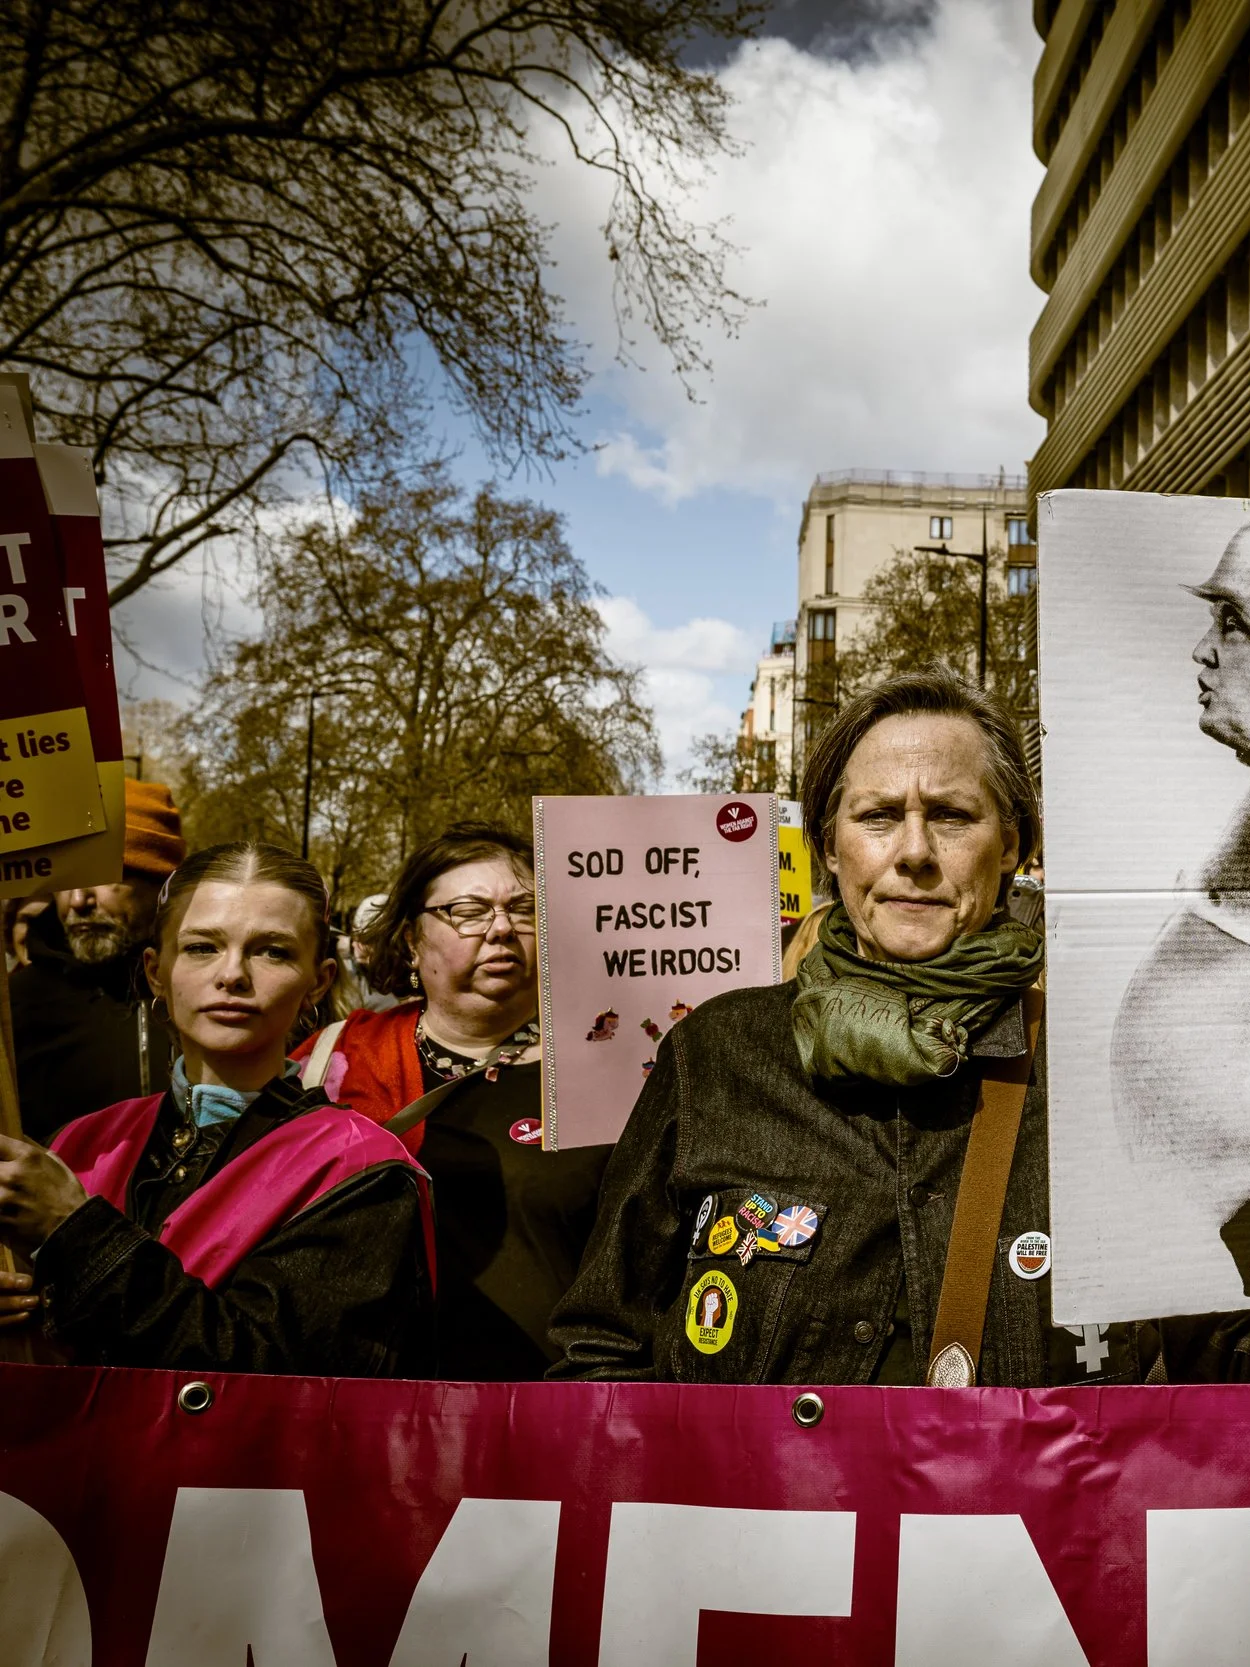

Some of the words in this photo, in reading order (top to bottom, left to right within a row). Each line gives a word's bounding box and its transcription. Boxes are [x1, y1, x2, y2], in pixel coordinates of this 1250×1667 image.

[16, 729, 71, 759] lies
[567, 849, 624, 878] SOD
[645, 847, 701, 879] OFF,
[596, 900, 712, 932] FASCIST
[603, 947, 741, 977] WEIRDOS!
[744, 1199, 757, 1210] UP
[754, 1207, 766, 1219] TO
[750, 1193, 773, 1213] STAND
[738, 1206, 765, 1229] RACISM
[701, 1276, 711, 1289] SAYS
[711, 1275, 719, 1285] NO
[719, 1277, 726, 1287] TO
[724, 1284, 734, 1303] HATE
[699, 1327, 719, 1339] EXPECT
